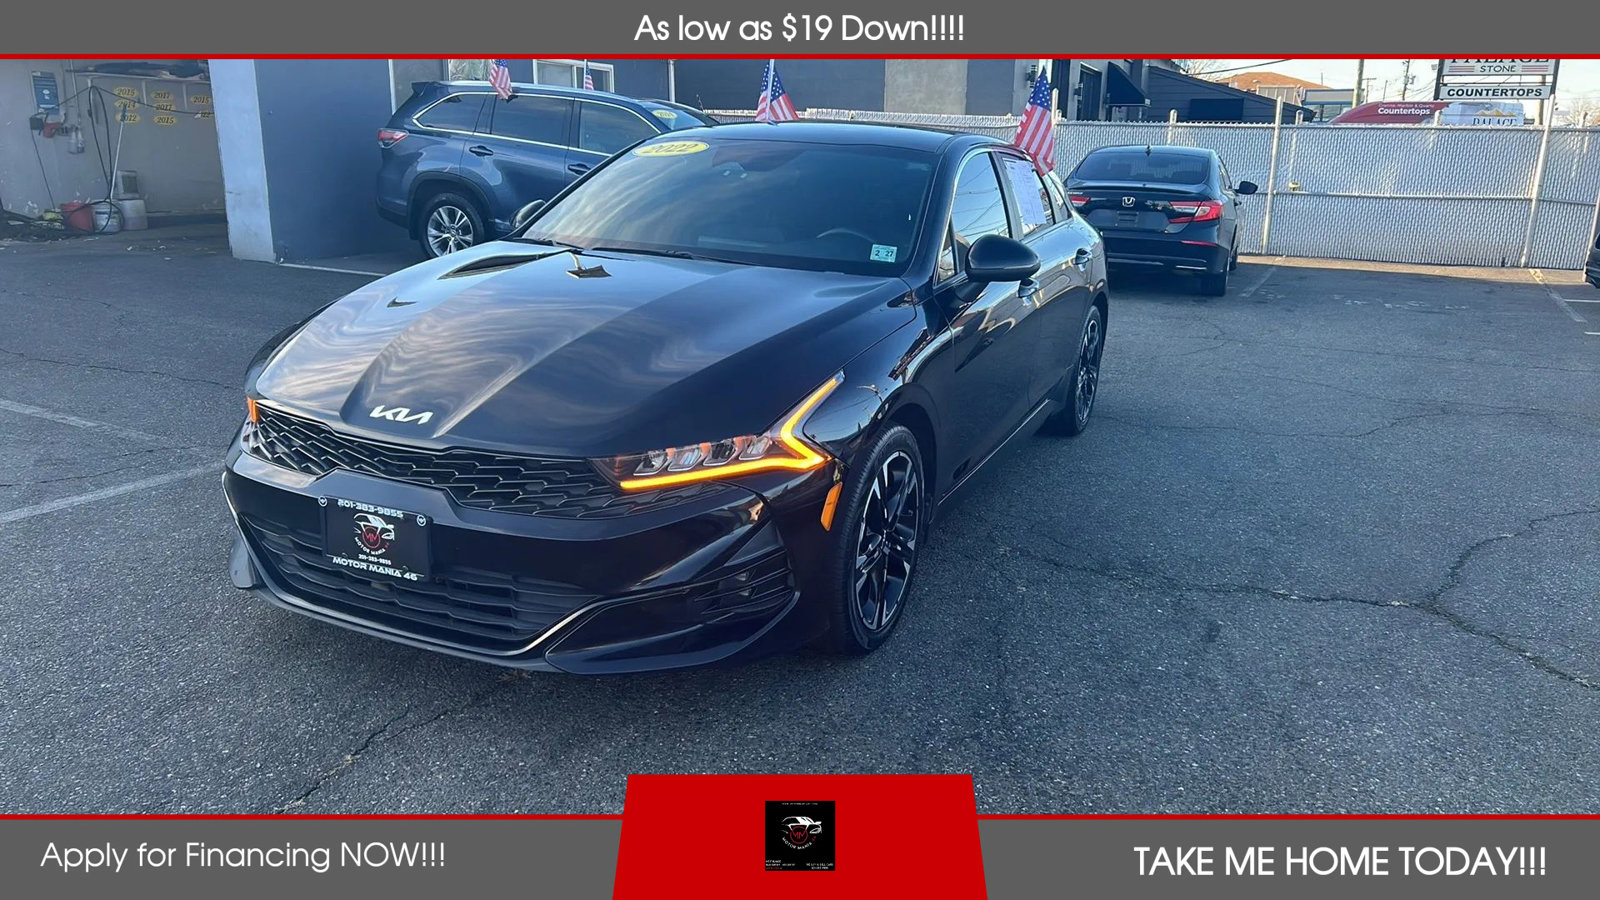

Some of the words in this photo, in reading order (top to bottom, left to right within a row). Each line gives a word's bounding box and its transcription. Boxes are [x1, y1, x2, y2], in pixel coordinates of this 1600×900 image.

[1479, 65, 1516, 73] STONE
[1447, 88, 1543, 97] COUNTERTOPS
[1377, 107, 1431, 117] Countertops
[338, 499, 403, 518] 201-383-9855
[333, 556, 367, 570] MOTOR
[369, 563, 402, 578] MANIA
[403, 571, 418, 581] 46
